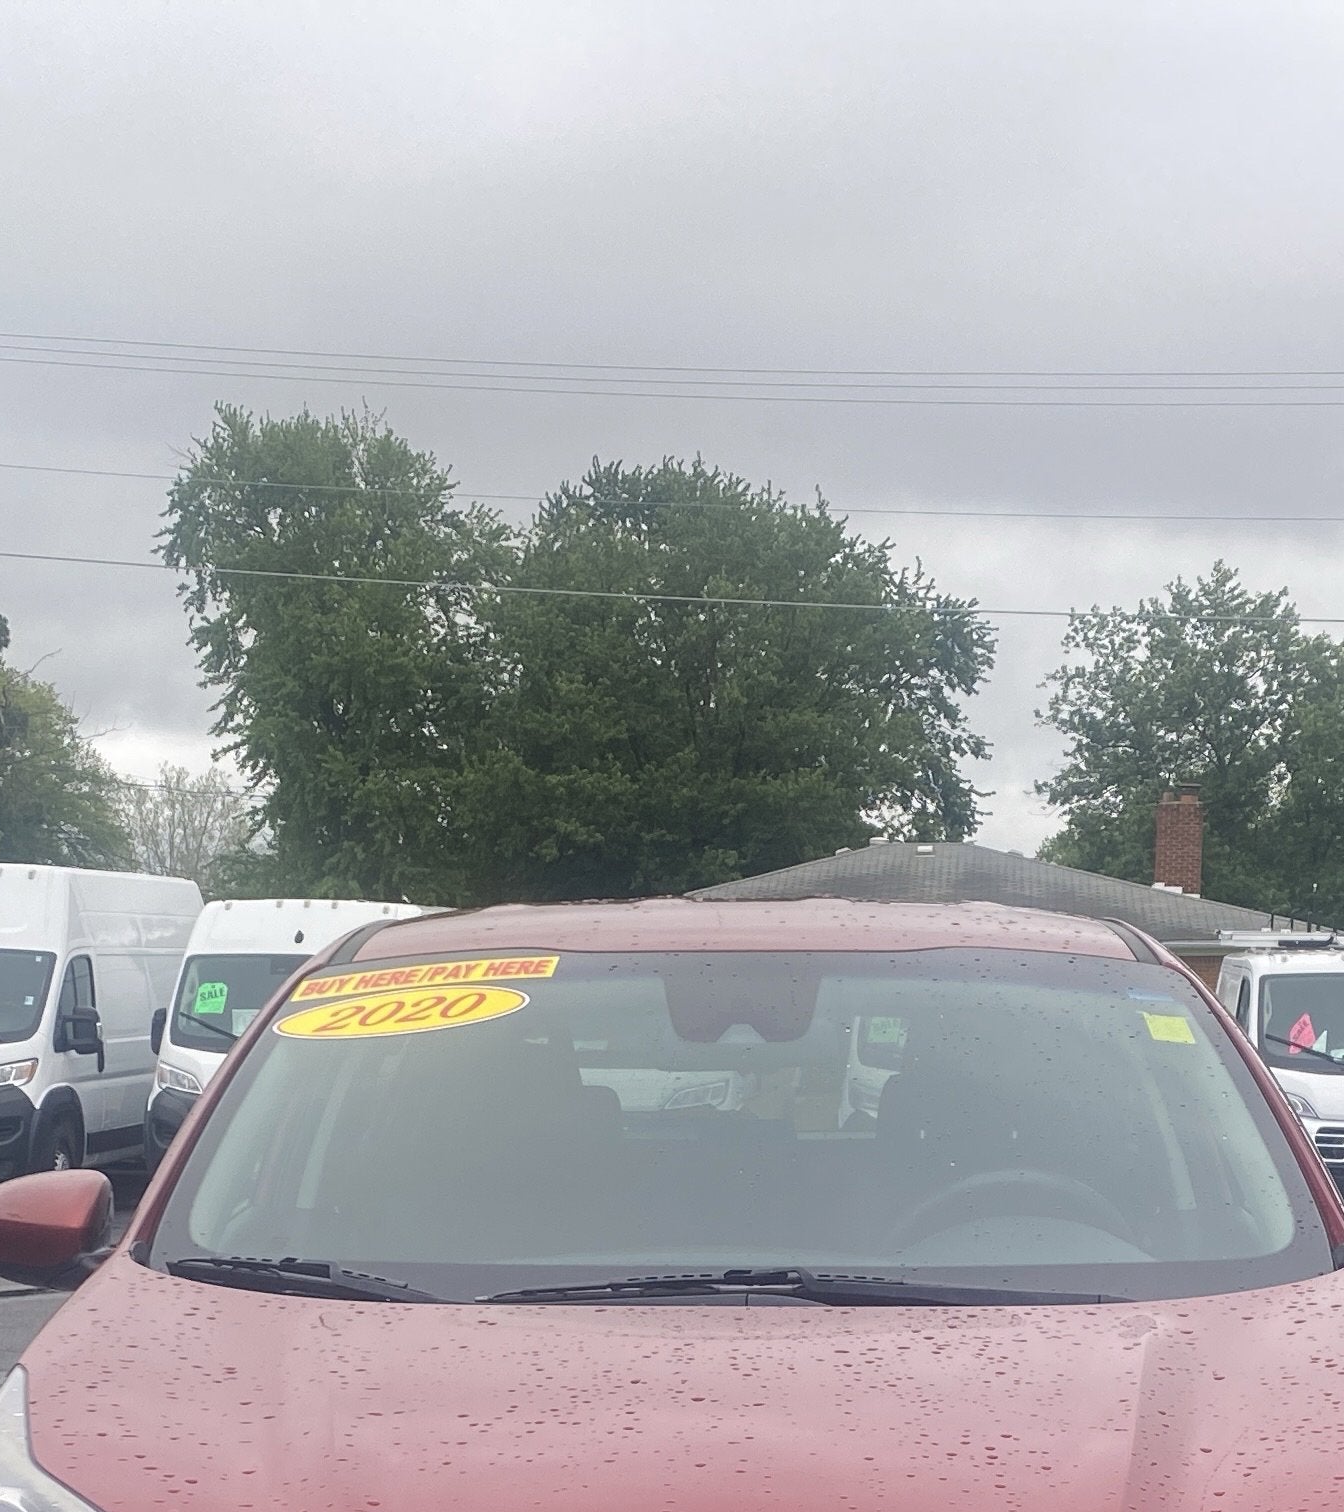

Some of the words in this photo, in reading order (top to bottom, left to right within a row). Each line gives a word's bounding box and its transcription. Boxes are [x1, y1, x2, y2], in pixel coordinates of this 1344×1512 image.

[199, 988, 226, 1002] SALE
[299, 976, 354, 997] BUY
[482, 959, 554, 977] HERE
[312, 992, 487, 1033] 2020
